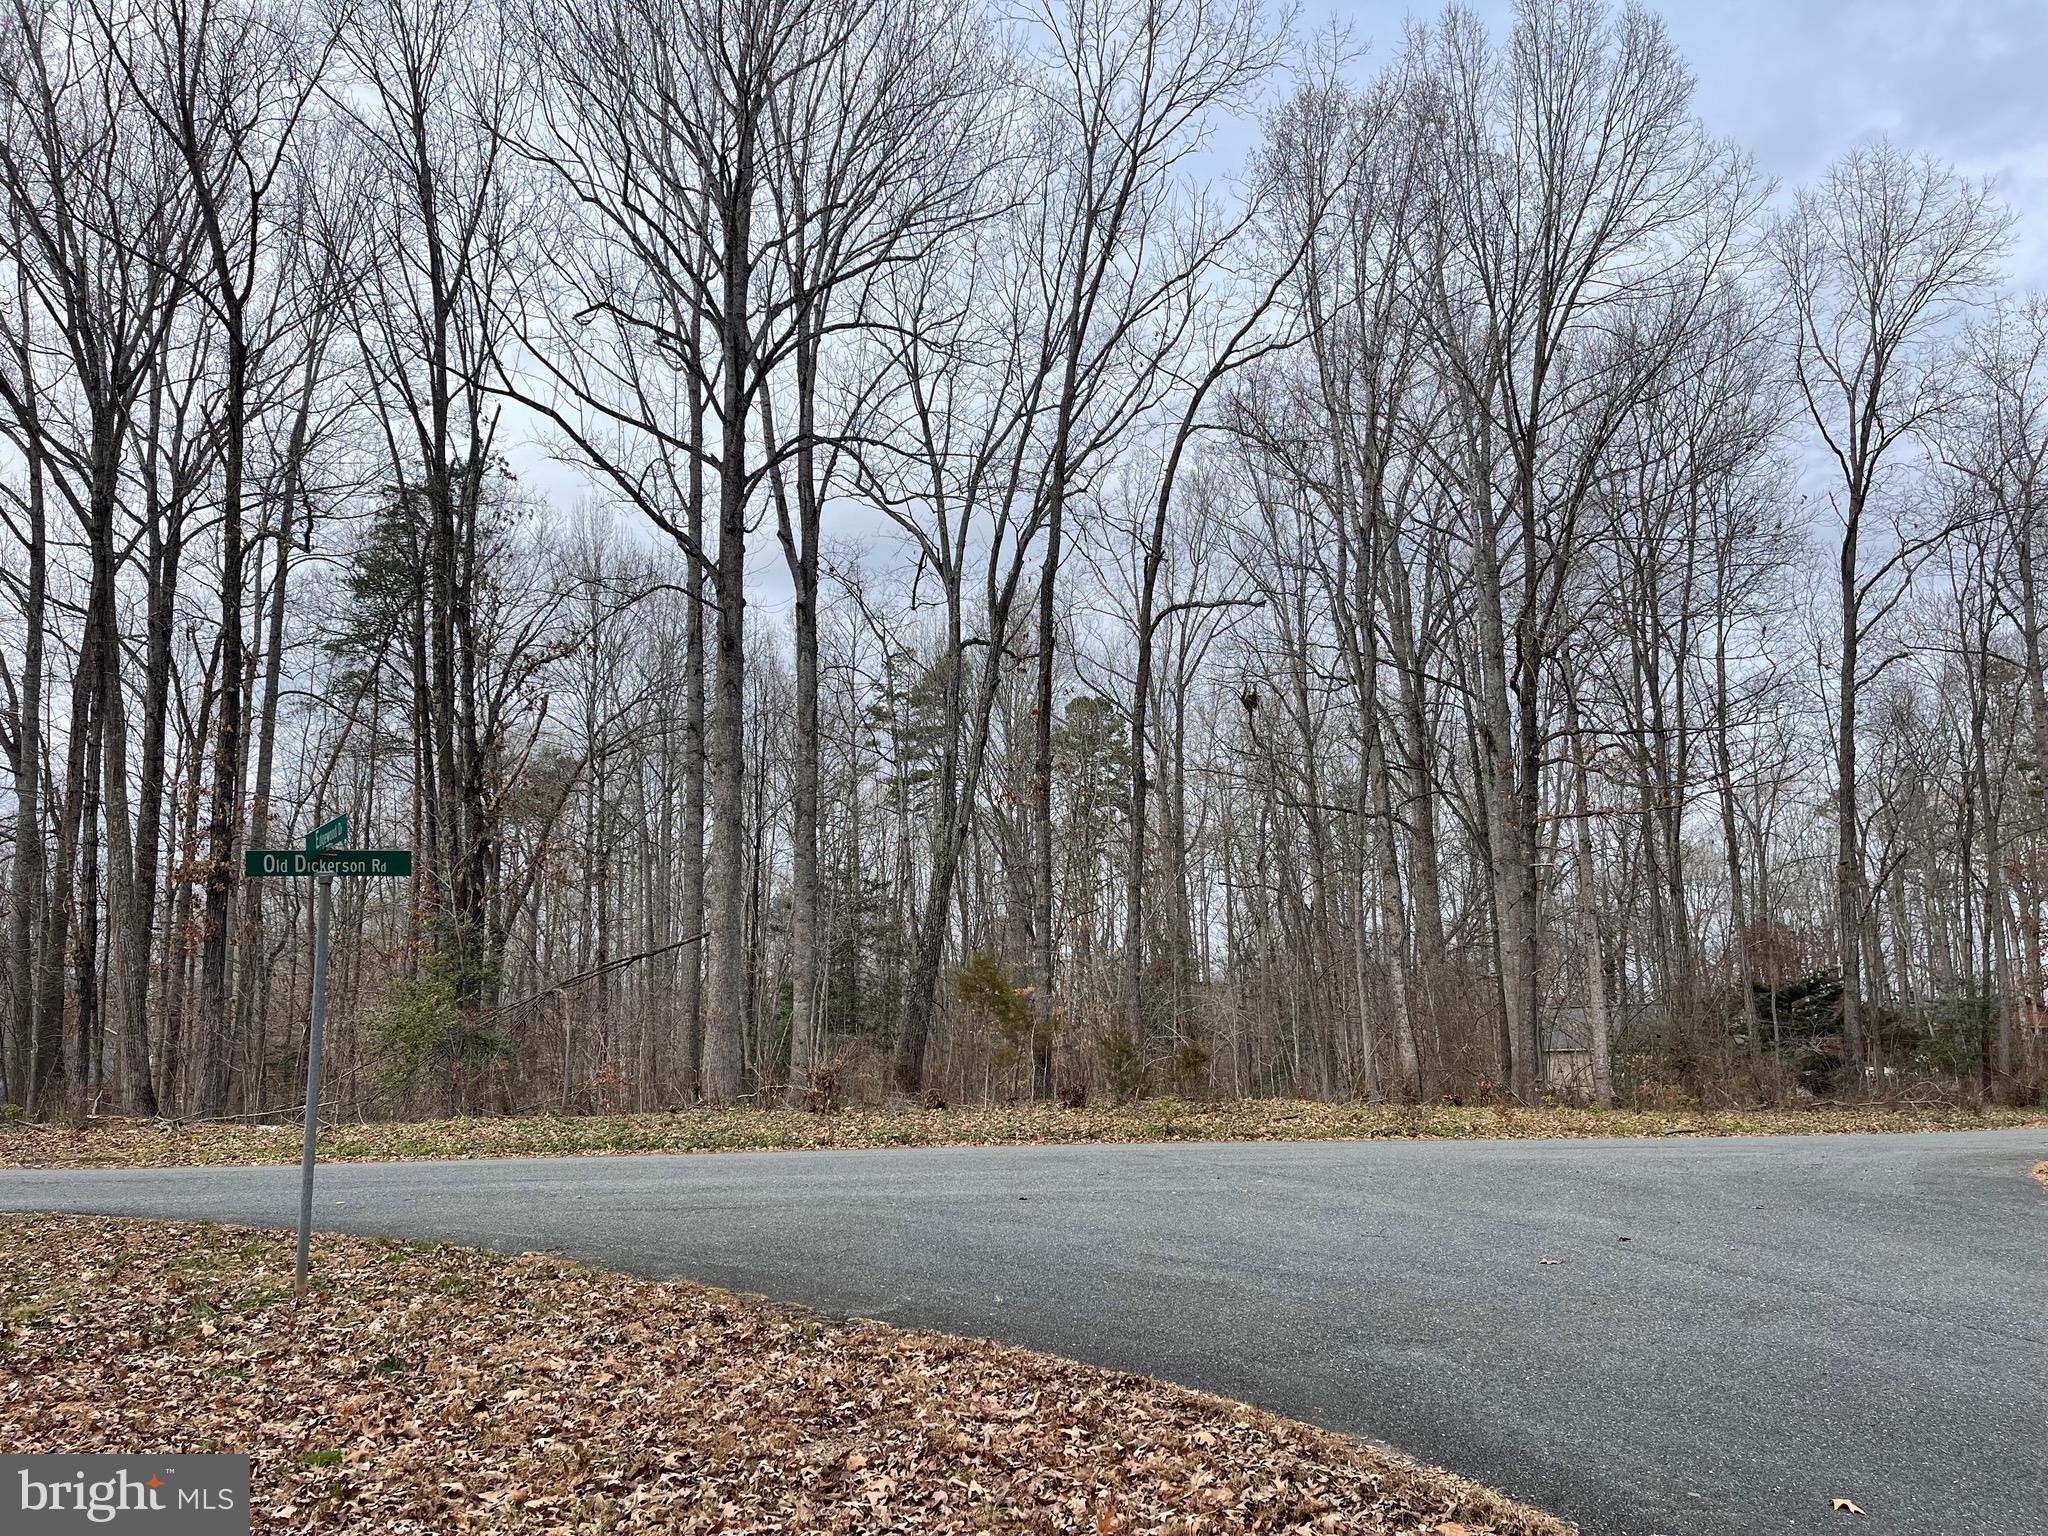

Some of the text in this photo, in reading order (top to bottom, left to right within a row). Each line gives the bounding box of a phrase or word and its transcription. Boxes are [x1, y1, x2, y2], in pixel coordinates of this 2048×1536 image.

[263, 854, 386, 873] Old Dickerson Rd
